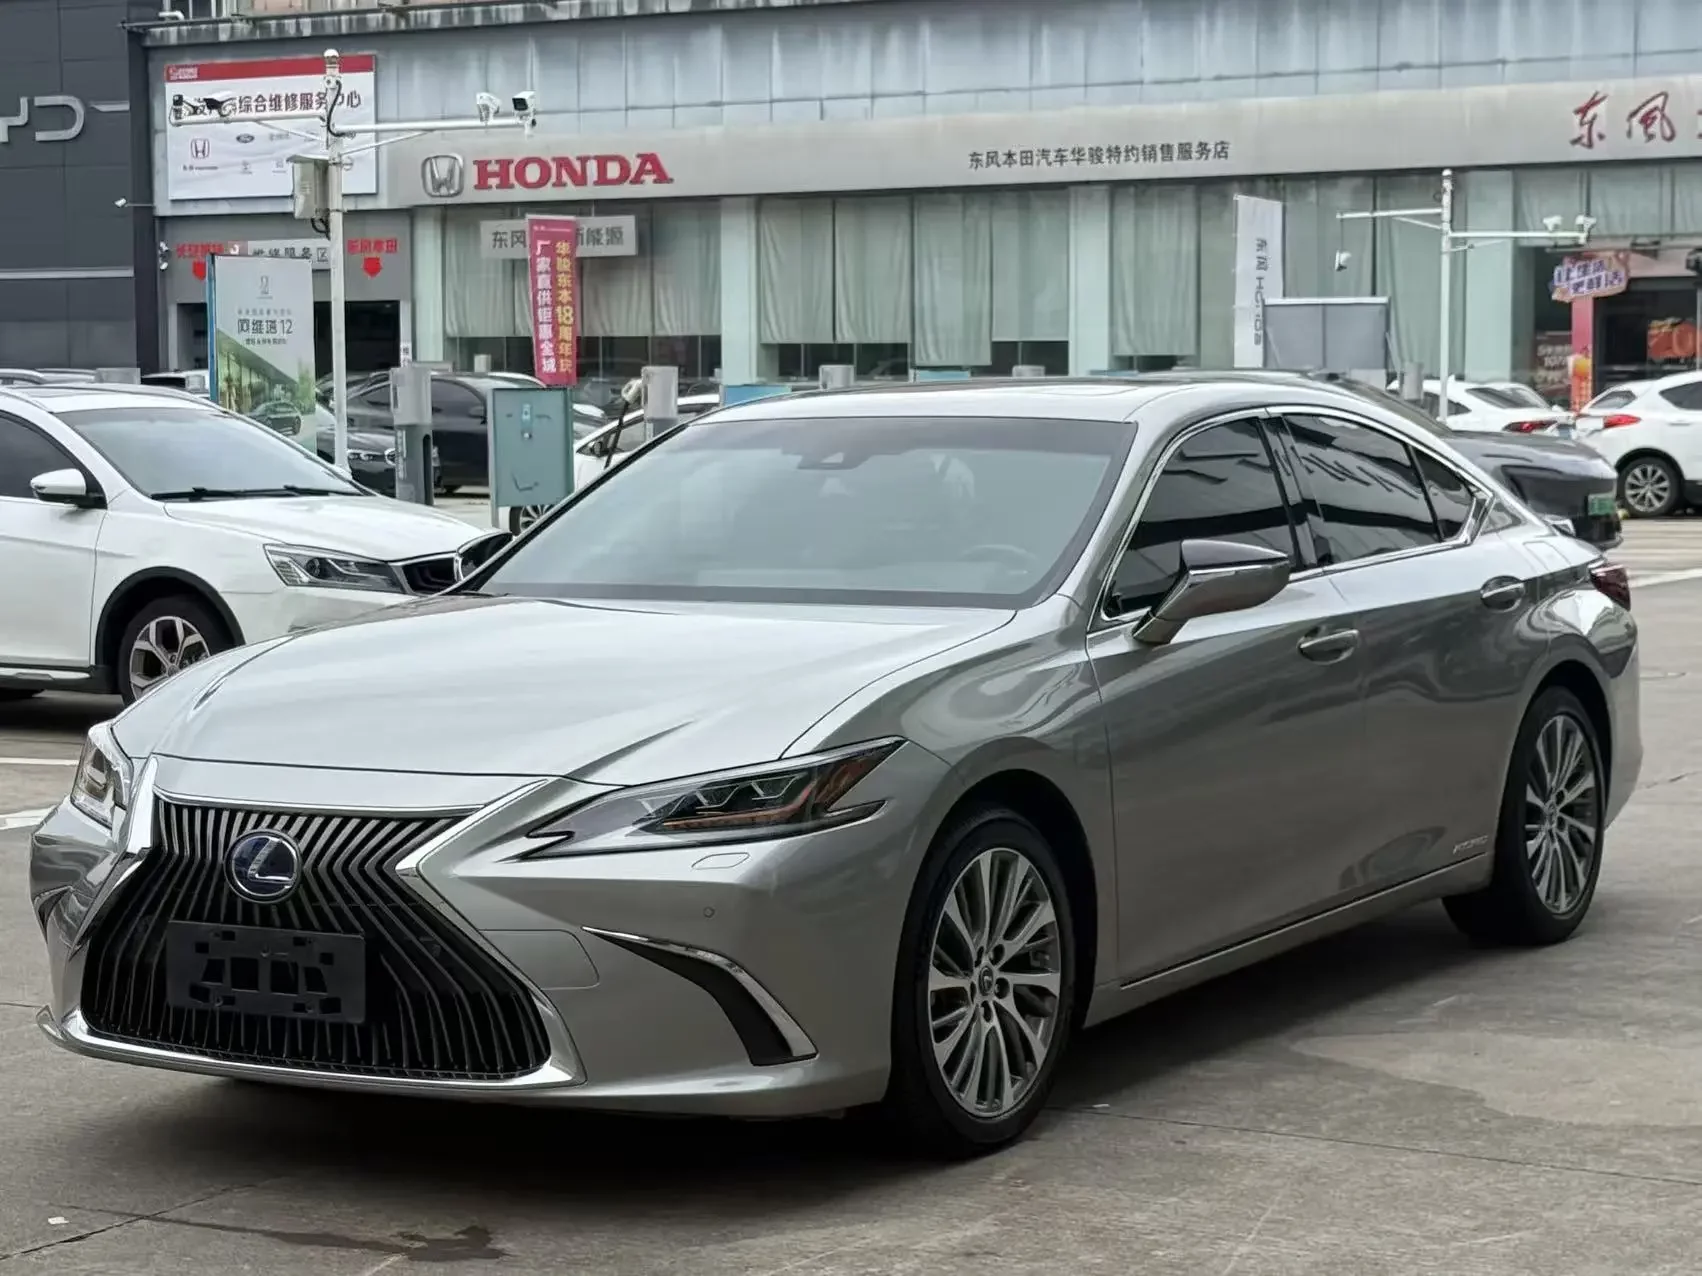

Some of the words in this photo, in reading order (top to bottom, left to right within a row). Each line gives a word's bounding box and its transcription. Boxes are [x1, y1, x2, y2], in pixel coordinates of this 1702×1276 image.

[473, 152, 674, 190] HONDA
[968, 140, 1230, 170] 东风本田汽车华骏特约销售服务店
